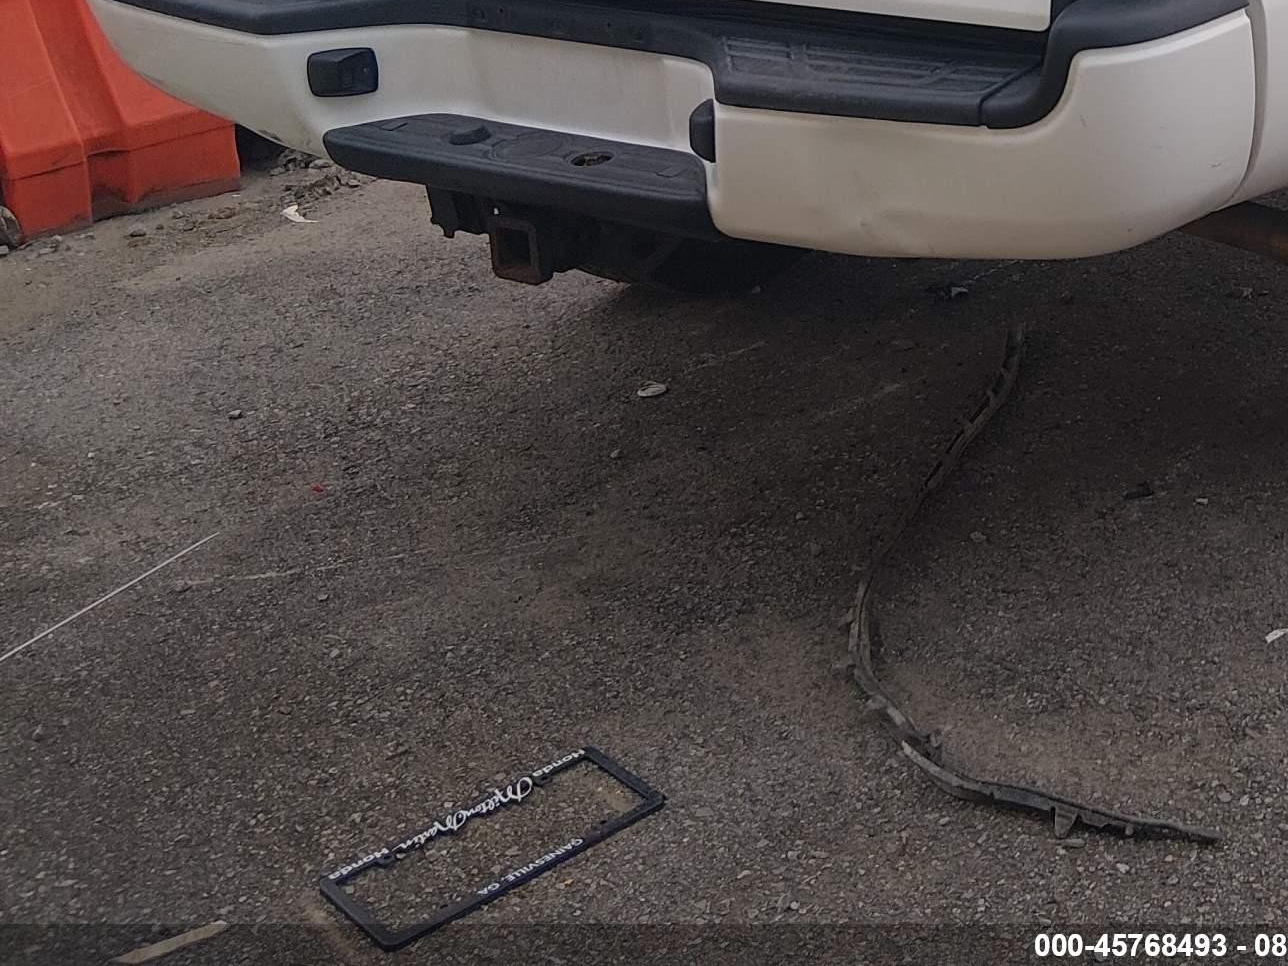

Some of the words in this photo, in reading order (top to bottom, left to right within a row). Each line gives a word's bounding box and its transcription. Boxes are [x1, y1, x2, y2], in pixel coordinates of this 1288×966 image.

[532, 748, 585, 778] Honda
[328, 847, 389, 880] Honda
[500, 838, 583, 883] GAINESVILLE,
[477, 882, 500, 895] GA
